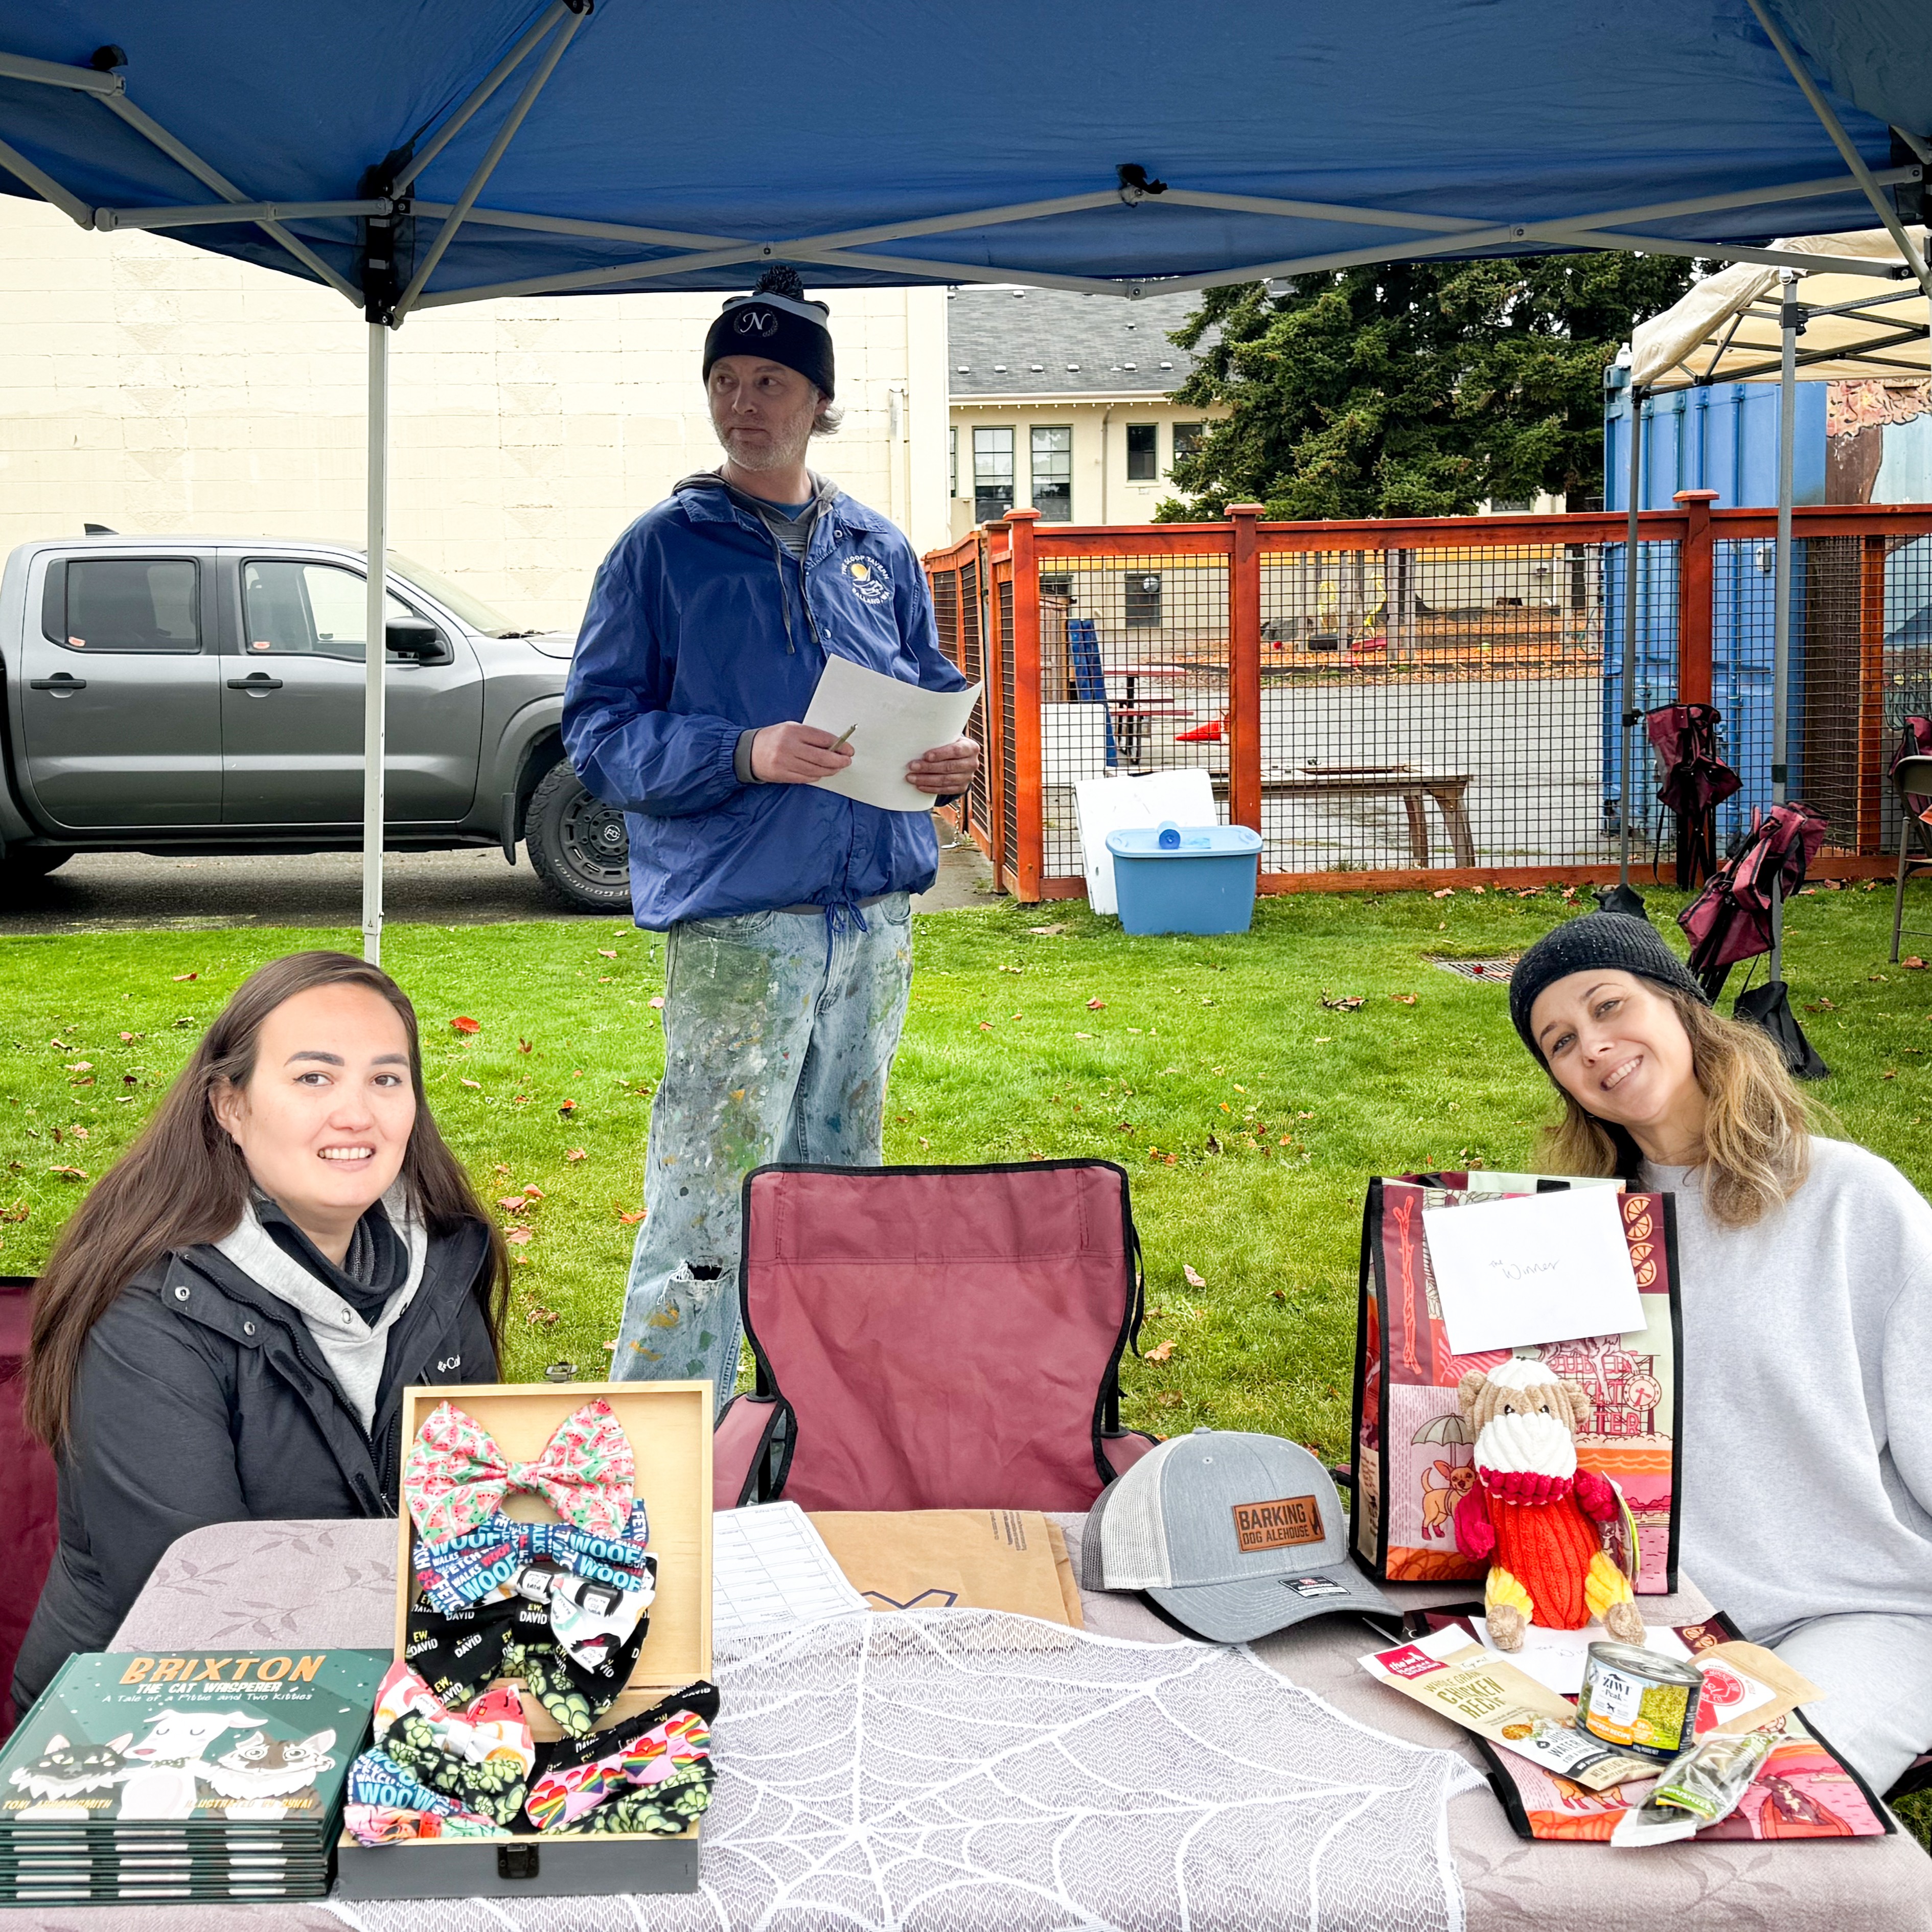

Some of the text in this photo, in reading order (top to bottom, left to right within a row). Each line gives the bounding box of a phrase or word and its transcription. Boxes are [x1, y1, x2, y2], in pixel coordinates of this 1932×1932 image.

[740, 312, 771, 333] N
[844, 555, 865, 565] SLOOP
[866, 556, 890, 580] TAVERN
[1502, 1259, 1560, 1280] Winner
[1238, 1503, 1306, 1531] BARKING
[1243, 1525, 1310, 1545] DOG ALEHOUSE
[432, 1551, 459, 1567] WALKS
[570, 1534, 640, 1563] WOOF
[442, 1551, 482, 1579] FETCH
[451, 1563, 482, 1588] WALKS
[458, 1551, 517, 1601] WOOF
[580, 1555, 642, 1591] WOOF
[446, 1611, 475, 1621] DAVID
[519, 1611, 547, 1625] DAVID
[410, 1638, 438, 1657] DAVID
[454, 1634, 483, 1659] DAVID
[119, 1655, 327, 1684] BRIXTON
[136, 1682, 283, 1694] THE CAT WHISPERER
[146, 1694, 159, 1702] of
[178, 1693, 211, 1701] Pittie
[438, 1682, 464, 1706] DAVID
[1437, 1677, 1505, 1705] CHICKEN
[2, 1800, 31, 1810] TONI
[358, 1783, 413, 1809] WOO
